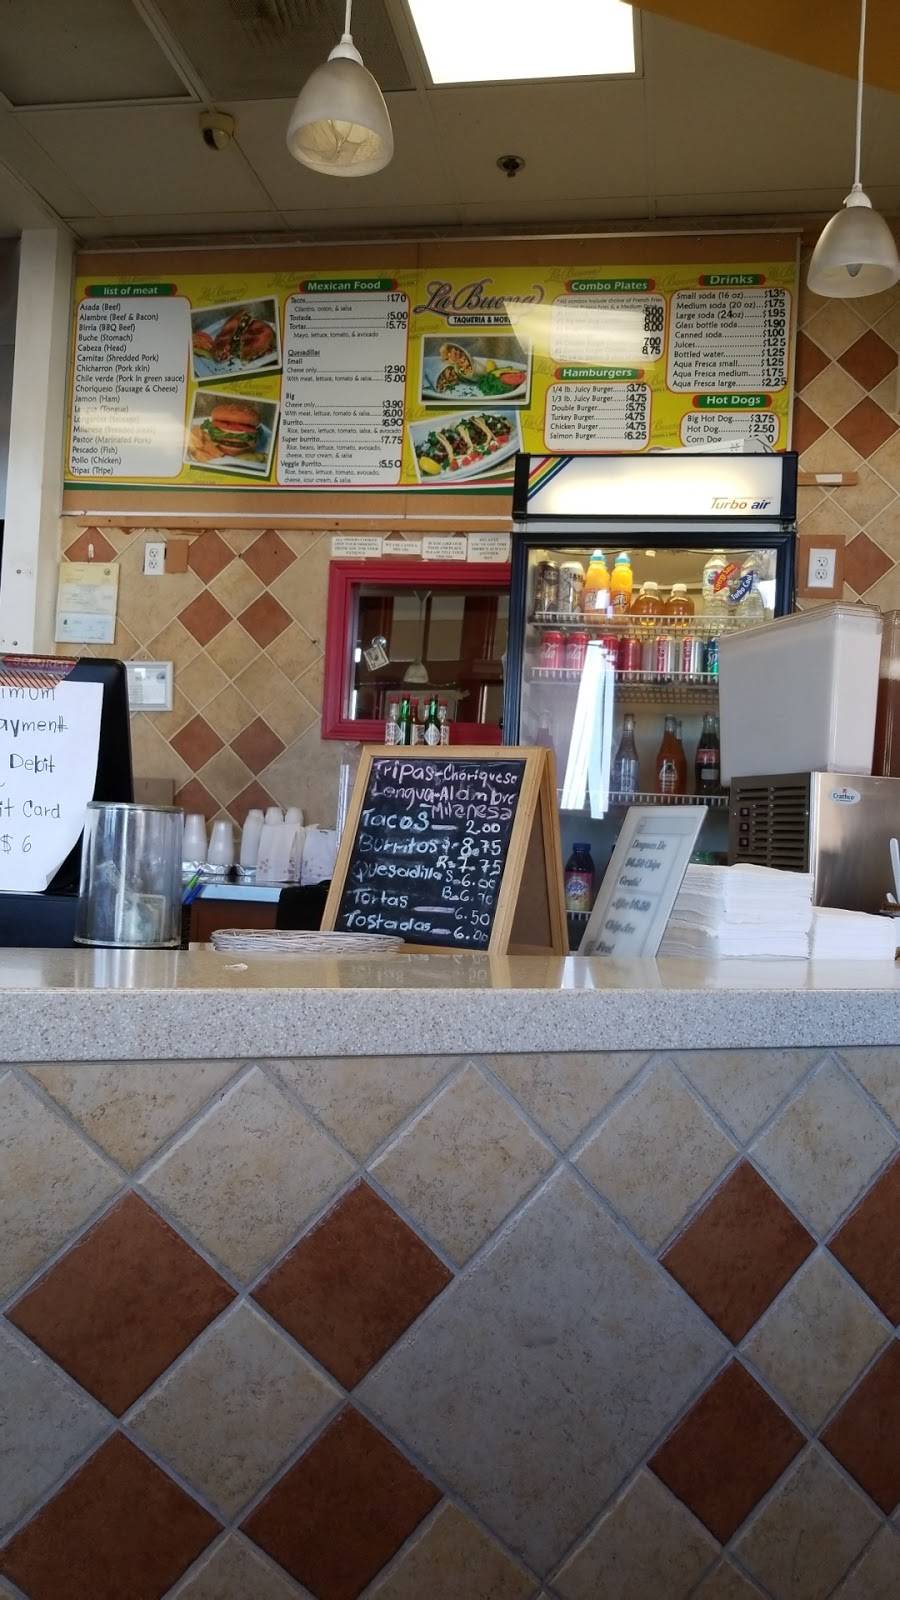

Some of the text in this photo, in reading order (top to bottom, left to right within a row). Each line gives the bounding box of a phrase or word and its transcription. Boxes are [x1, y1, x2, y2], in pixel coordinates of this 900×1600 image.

[710, 275, 754, 285] Drinks
[307, 281, 381, 291] Mexican Food
[572, 281, 648, 291] Combo Plates
[103, 287, 158, 295] list of meat
[676, 292, 697, 300] Small
[718, 291, 730, 300] (16
[731, 292, 744, 300] oz)
[79, 303, 121, 312] Asada (Beef)
[676, 302, 707, 310] Medium
[729, 301, 742, 310] (20
[744, 301, 756, 310] oz)
[109, 313, 127, 322] (Beef
[135, 313, 159, 321] Bacon)
[676, 312, 695, 320] Large
[99, 323, 116, 333] (BBQ
[119, 323, 136, 332] Beef)
[675, 321, 693, 329] Glass
[695, 321, 718, 329] bottle
[100, 333, 133, 343] (Stomach)
[674, 331, 703, 339] Canned
[77, 344, 127, 353] Cabeza (Head)
[674, 341, 696, 349] Juices
[106, 354, 139, 362] (Shredded
[142, 353, 159, 362] Pork)
[77, 364, 150, 373] Chicharron (Pork skin)
[694, 360, 717, 368] Fresca
[563, 369, 632, 379] Hamburgers
[76, 374, 93, 382] Chile
[116, 374, 133, 383] (Pork
[144, 376, 162, 384] green
[164, 374, 185, 383] sauce)
[75, 384, 179, 394] Choriqueso (Sausage Cheese)
[718, 380, 736, 389] large
[574, 386, 591, 394] Juicy
[592, 386, 613, 394] Burger
[99, 395, 121, 403] (Ham)
[574, 395, 590, 403] Juicy
[592, 395, 613, 403] Burger
[706, 395, 761, 406] Hot Dogs
[576, 405, 597, 413] Burger
[551, 414, 571, 422] Turkey
[573, 414, 594, 422] Burger
[687, 415, 699, 424] Big
[717, 415, 733, 424] Dog
[750, 414, 775, 424] $3.75
[577, 423, 599, 431] Burger
[686, 424, 775, 434] Hot Dog $2.50
[575, 433, 596, 441] Burger
[72, 446, 118, 455] Pescado (Fish)
[71, 456, 122, 465] Pollo (Chicken)
[92, 466, 113, 475] (Tripe)
[711, 497, 771, 510] Turbo air
[9, 753, 56, 774] Debit
[22, 799, 61, 819] Card
[362, 807, 501, 835] Tacos 2.00
[21, 834, 32, 853] 6
[359, 833, 502, 858] Burritos 8.75
[354, 888, 491, 926] Tortas 6.50
[343, 910, 489, 942] Tostadas 6.00
